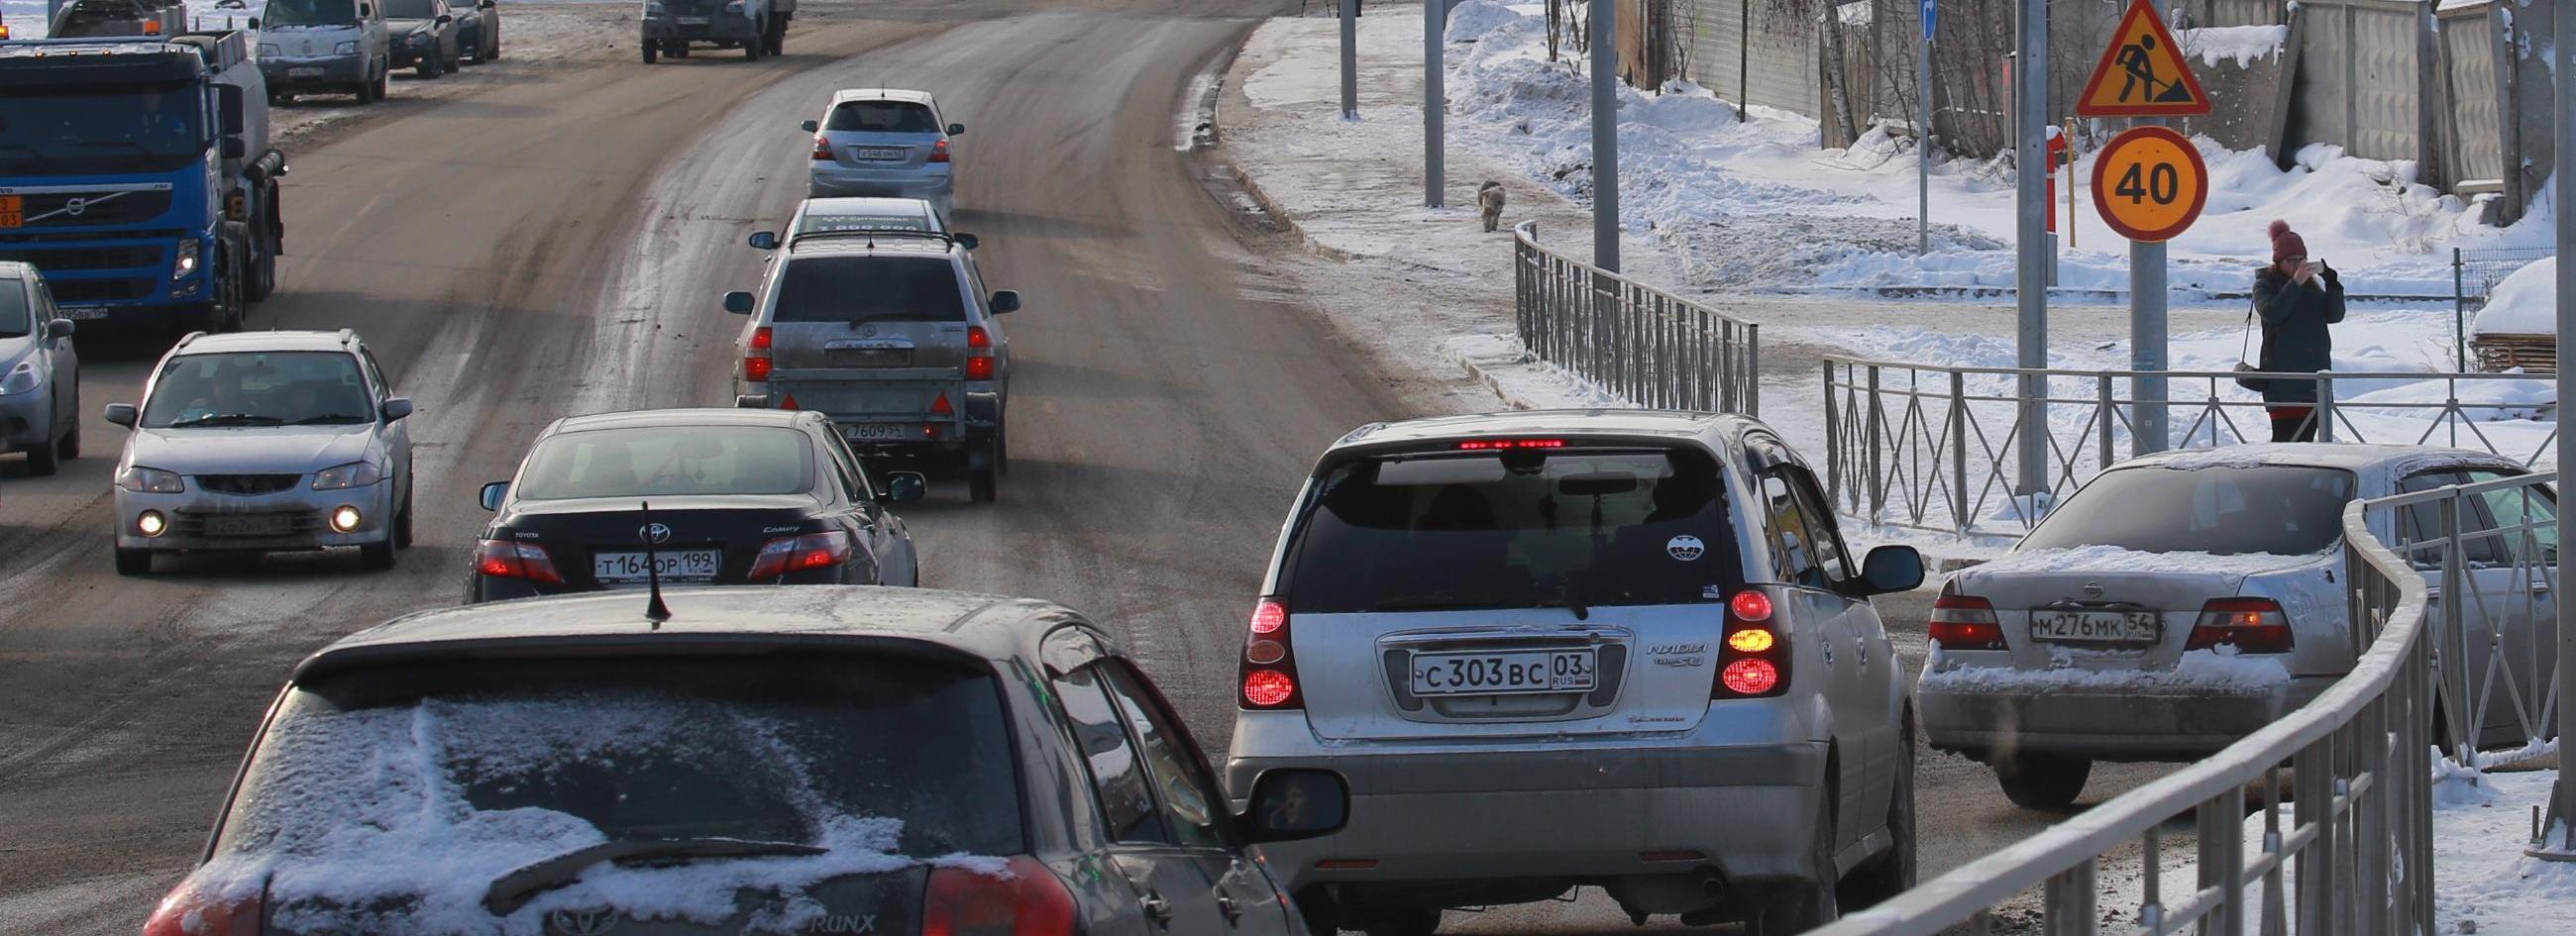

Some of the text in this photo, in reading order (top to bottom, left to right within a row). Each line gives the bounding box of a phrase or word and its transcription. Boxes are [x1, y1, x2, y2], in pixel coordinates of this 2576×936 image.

[2114, 161, 2179, 206] 40
[854, 425, 886, 438] 7609
[683, 553, 711, 568] 199
[2039, 613, 2149, 637] М276МК 54
[1647, 644, 1709, 655] NADIA
[1426, 654, 1583, 688] С303ВС 03
[1553, 676, 1574, 685] RUS
[810, 913, 877, 933] RUNX
